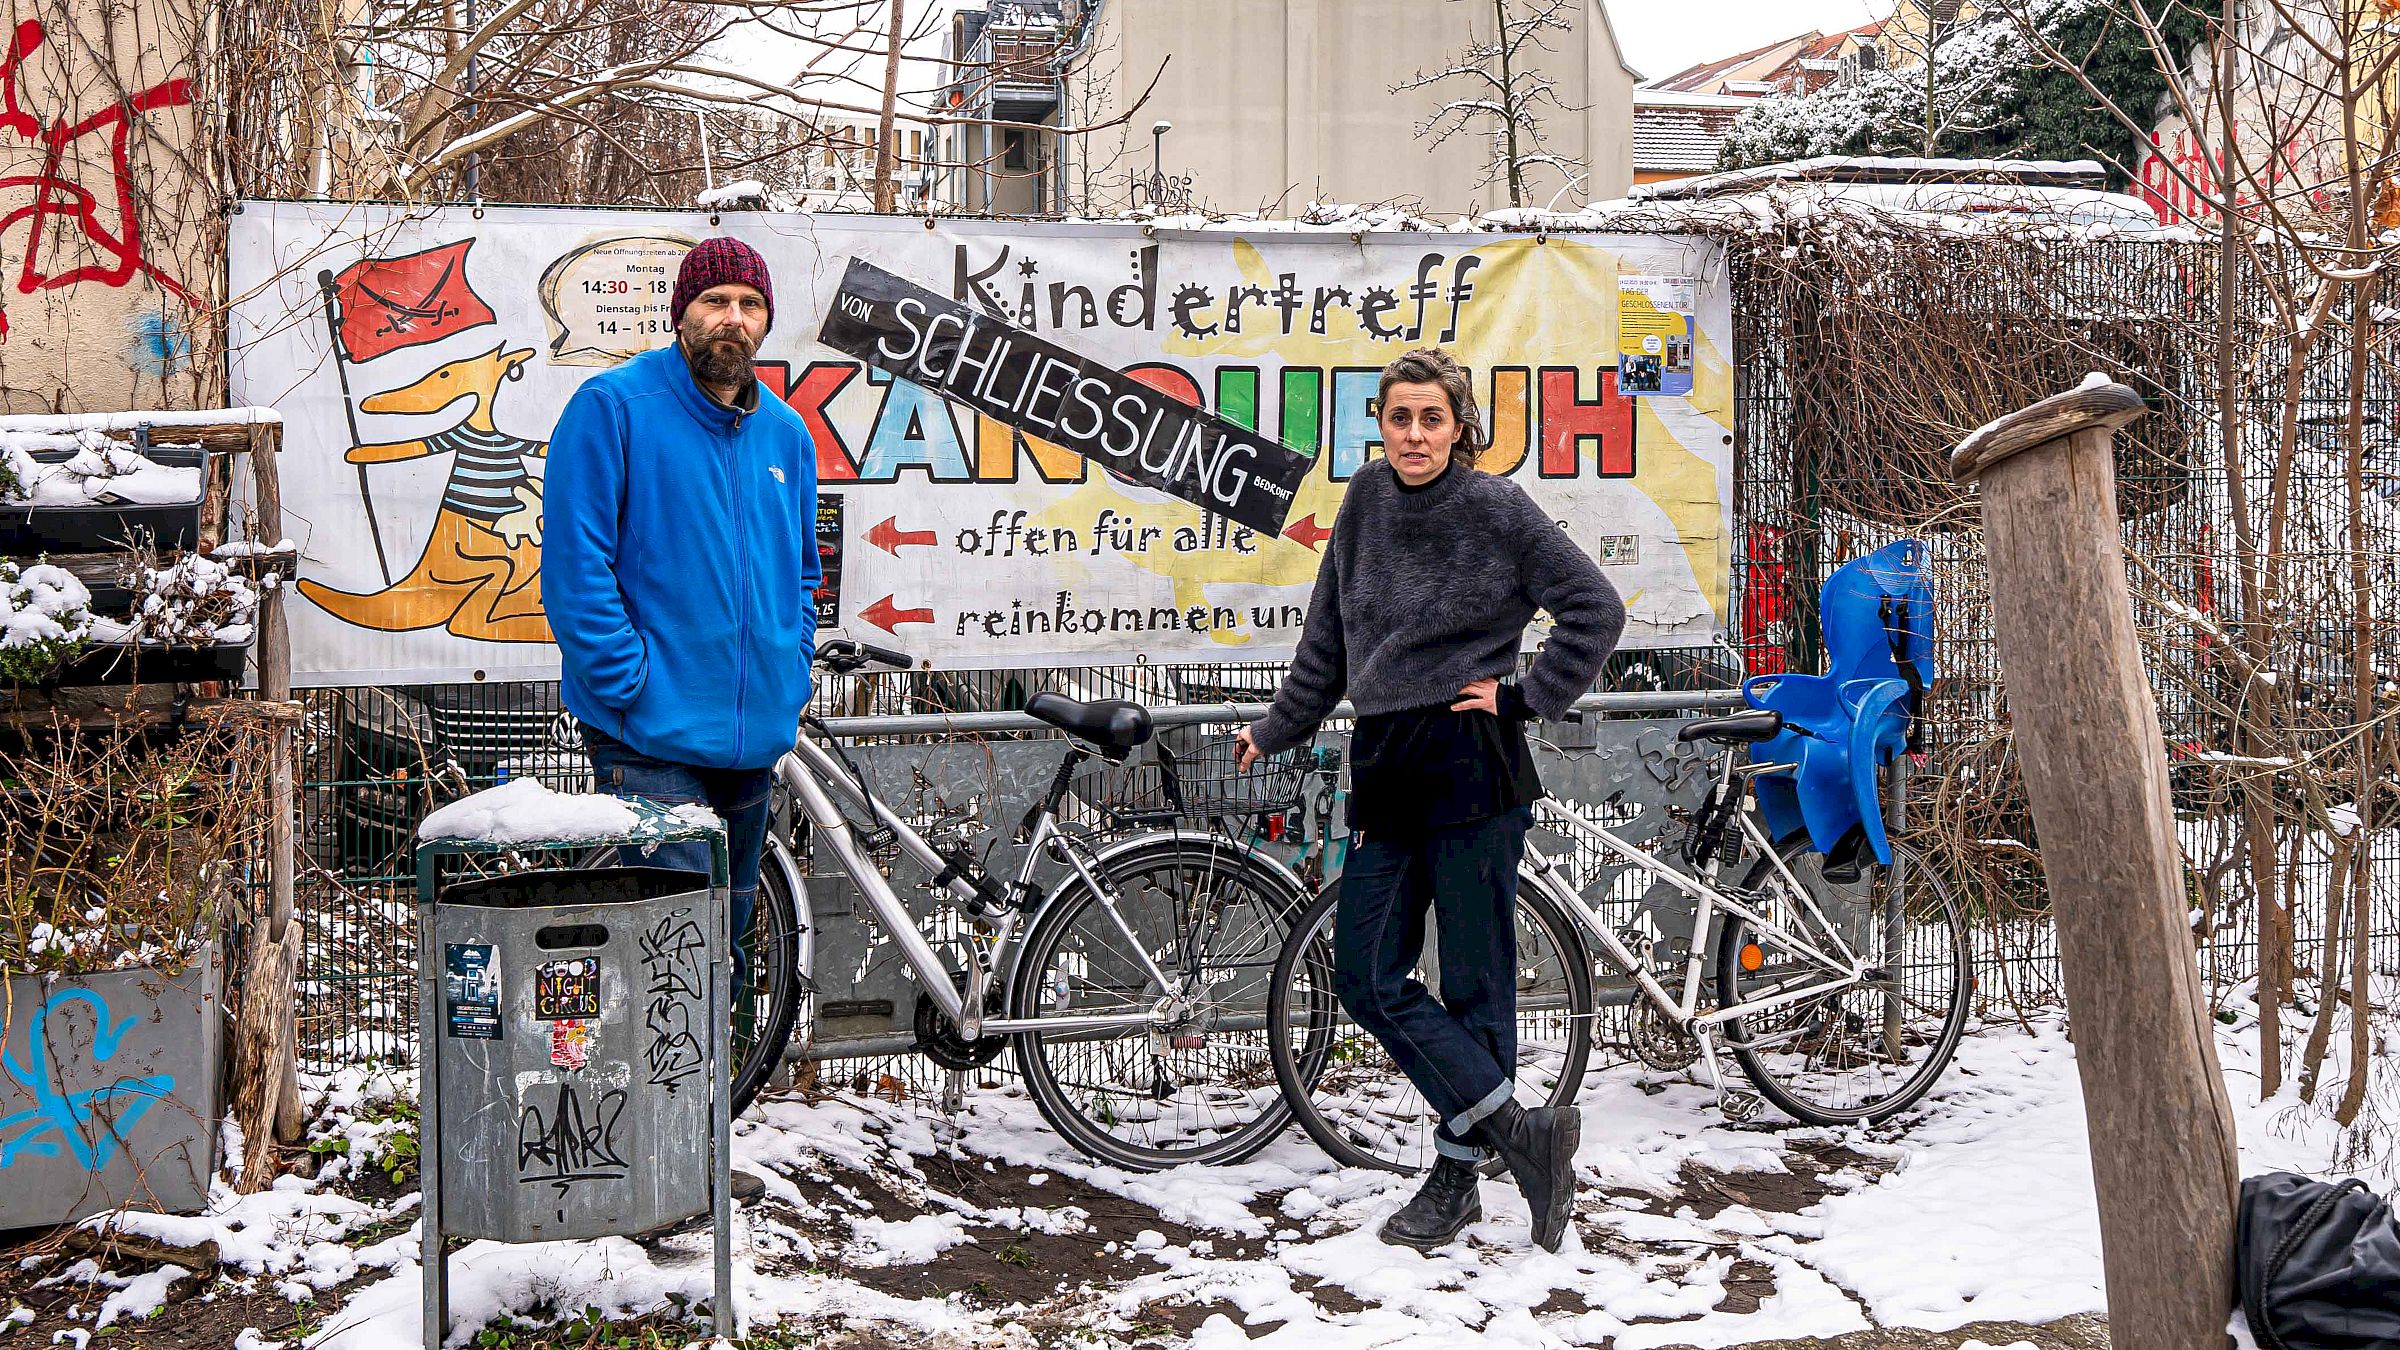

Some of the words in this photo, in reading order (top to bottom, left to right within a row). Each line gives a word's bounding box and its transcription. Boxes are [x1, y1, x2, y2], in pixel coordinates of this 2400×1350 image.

[613, 248, 667, 257] Öffnungszeiten
[626, 264, 665, 275] Montag
[581, 280, 629, 294] 14:30
[648, 281, 667, 294] 18
[953, 244, 1482, 343] Kindertreff
[1622, 288, 1635, 296] TAG
[1636, 288, 1649, 296] DER
[596, 304, 641, 315] Dienstag
[643, 304, 658, 313] bis
[1621, 300, 1674, 309] GESCHLOSSENEN
[597, 321, 618, 335] 14
[637, 320, 657, 335] 18
[662, 321, 675, 334] U
[840, 292, 875, 323] VON
[877, 297, 1258, 508] SCHLIESSUNG
[1253, 476, 1294, 501] BEDROHT
[954, 509, 1078, 557] offen
[1090, 510, 1163, 556] für
[1173, 509, 1257, 555] alle
[955, 590, 1237, 639] reinkommen
[541, 958, 597, 979] GOOD
[539, 976, 597, 997] NIGHT
[539, 994, 598, 1015] CIRCUS
